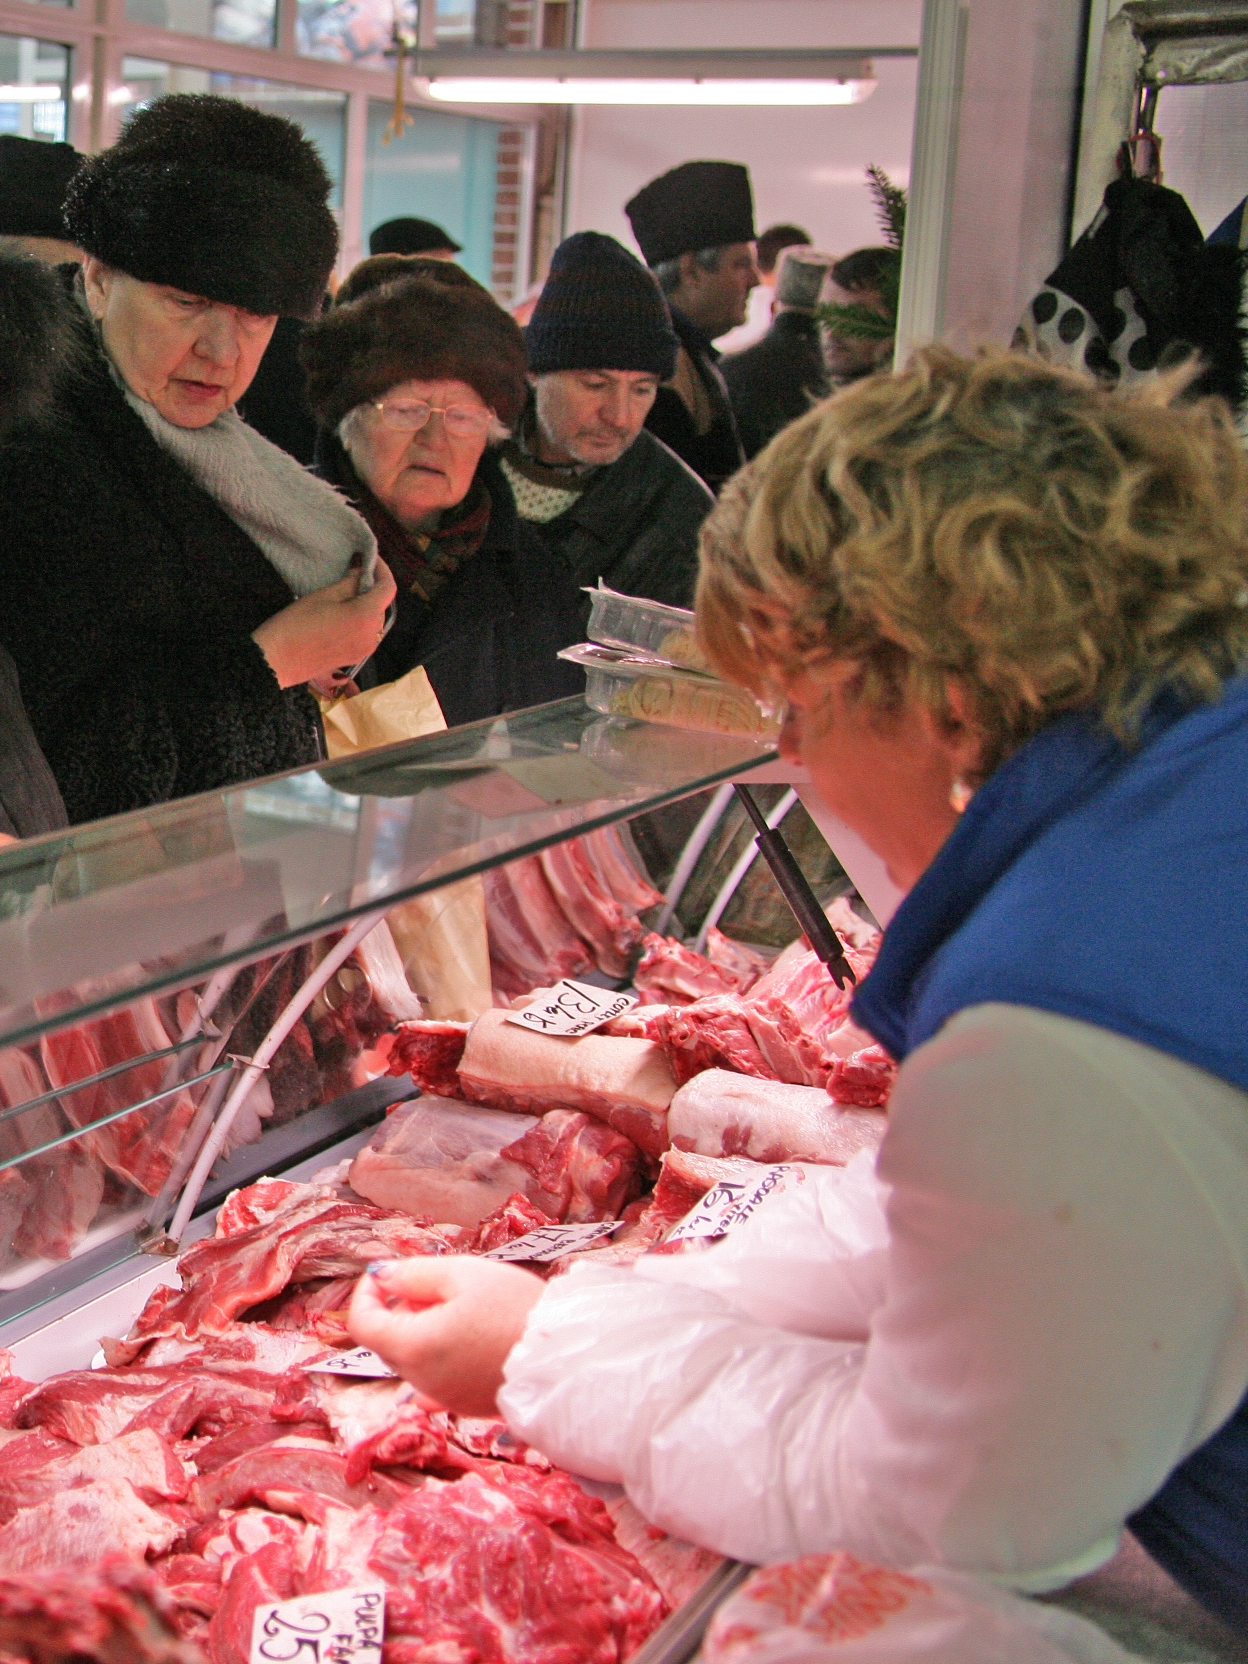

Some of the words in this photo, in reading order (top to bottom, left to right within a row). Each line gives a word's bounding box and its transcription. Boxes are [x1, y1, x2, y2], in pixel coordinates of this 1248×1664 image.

[557, 980, 601, 1014] 13
[703, 1182, 747, 1209] 16
[259, 1609, 331, 1664] 25
[352, 1593, 383, 1650] PULPA
